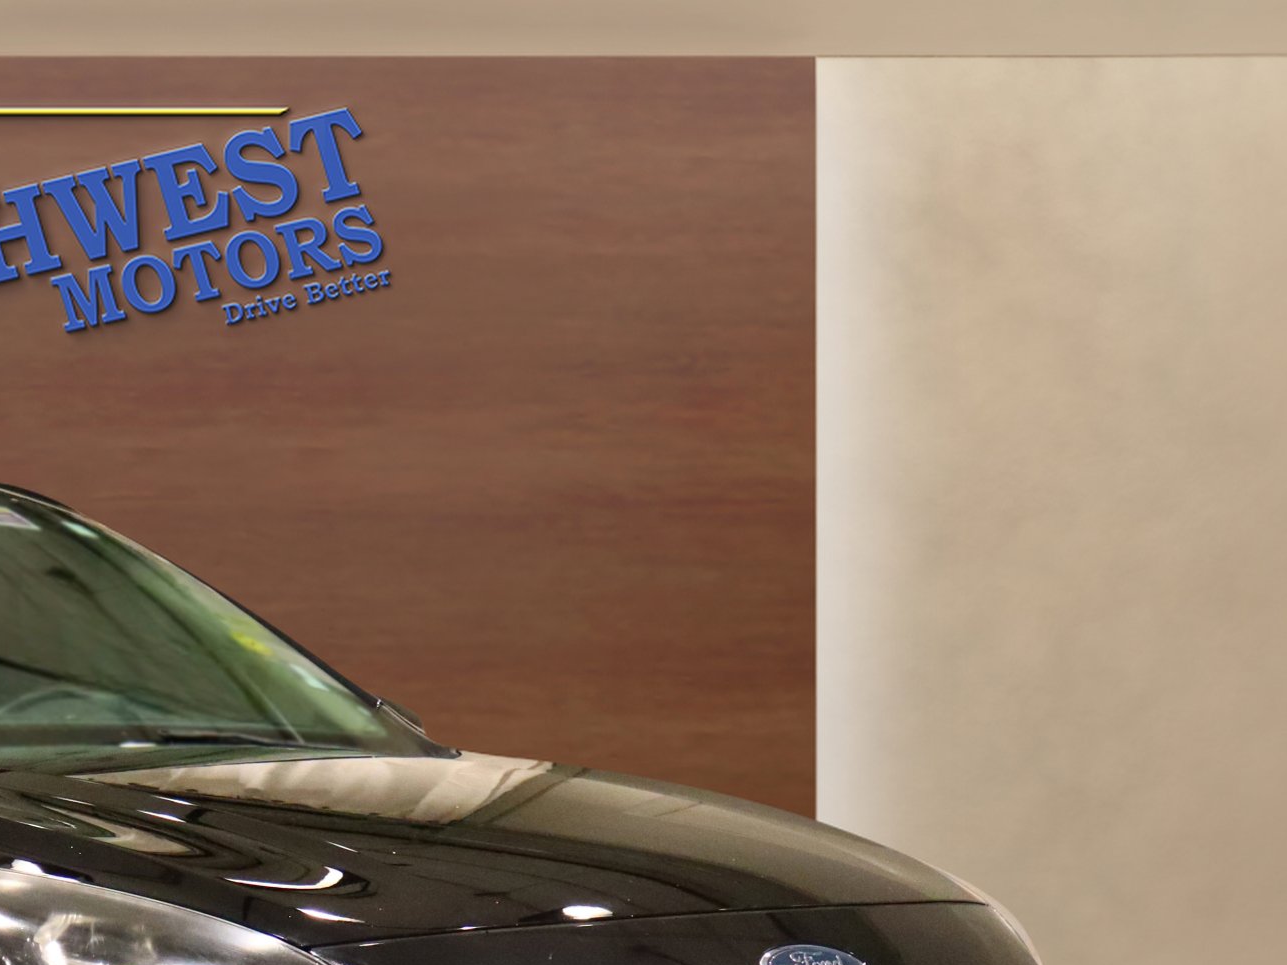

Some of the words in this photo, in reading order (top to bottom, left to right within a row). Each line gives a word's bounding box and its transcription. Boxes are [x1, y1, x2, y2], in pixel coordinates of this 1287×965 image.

[50, 204, 383, 333] MOTORS
[222, 295, 298, 325] Drive
[303, 270, 391, 305] Better
